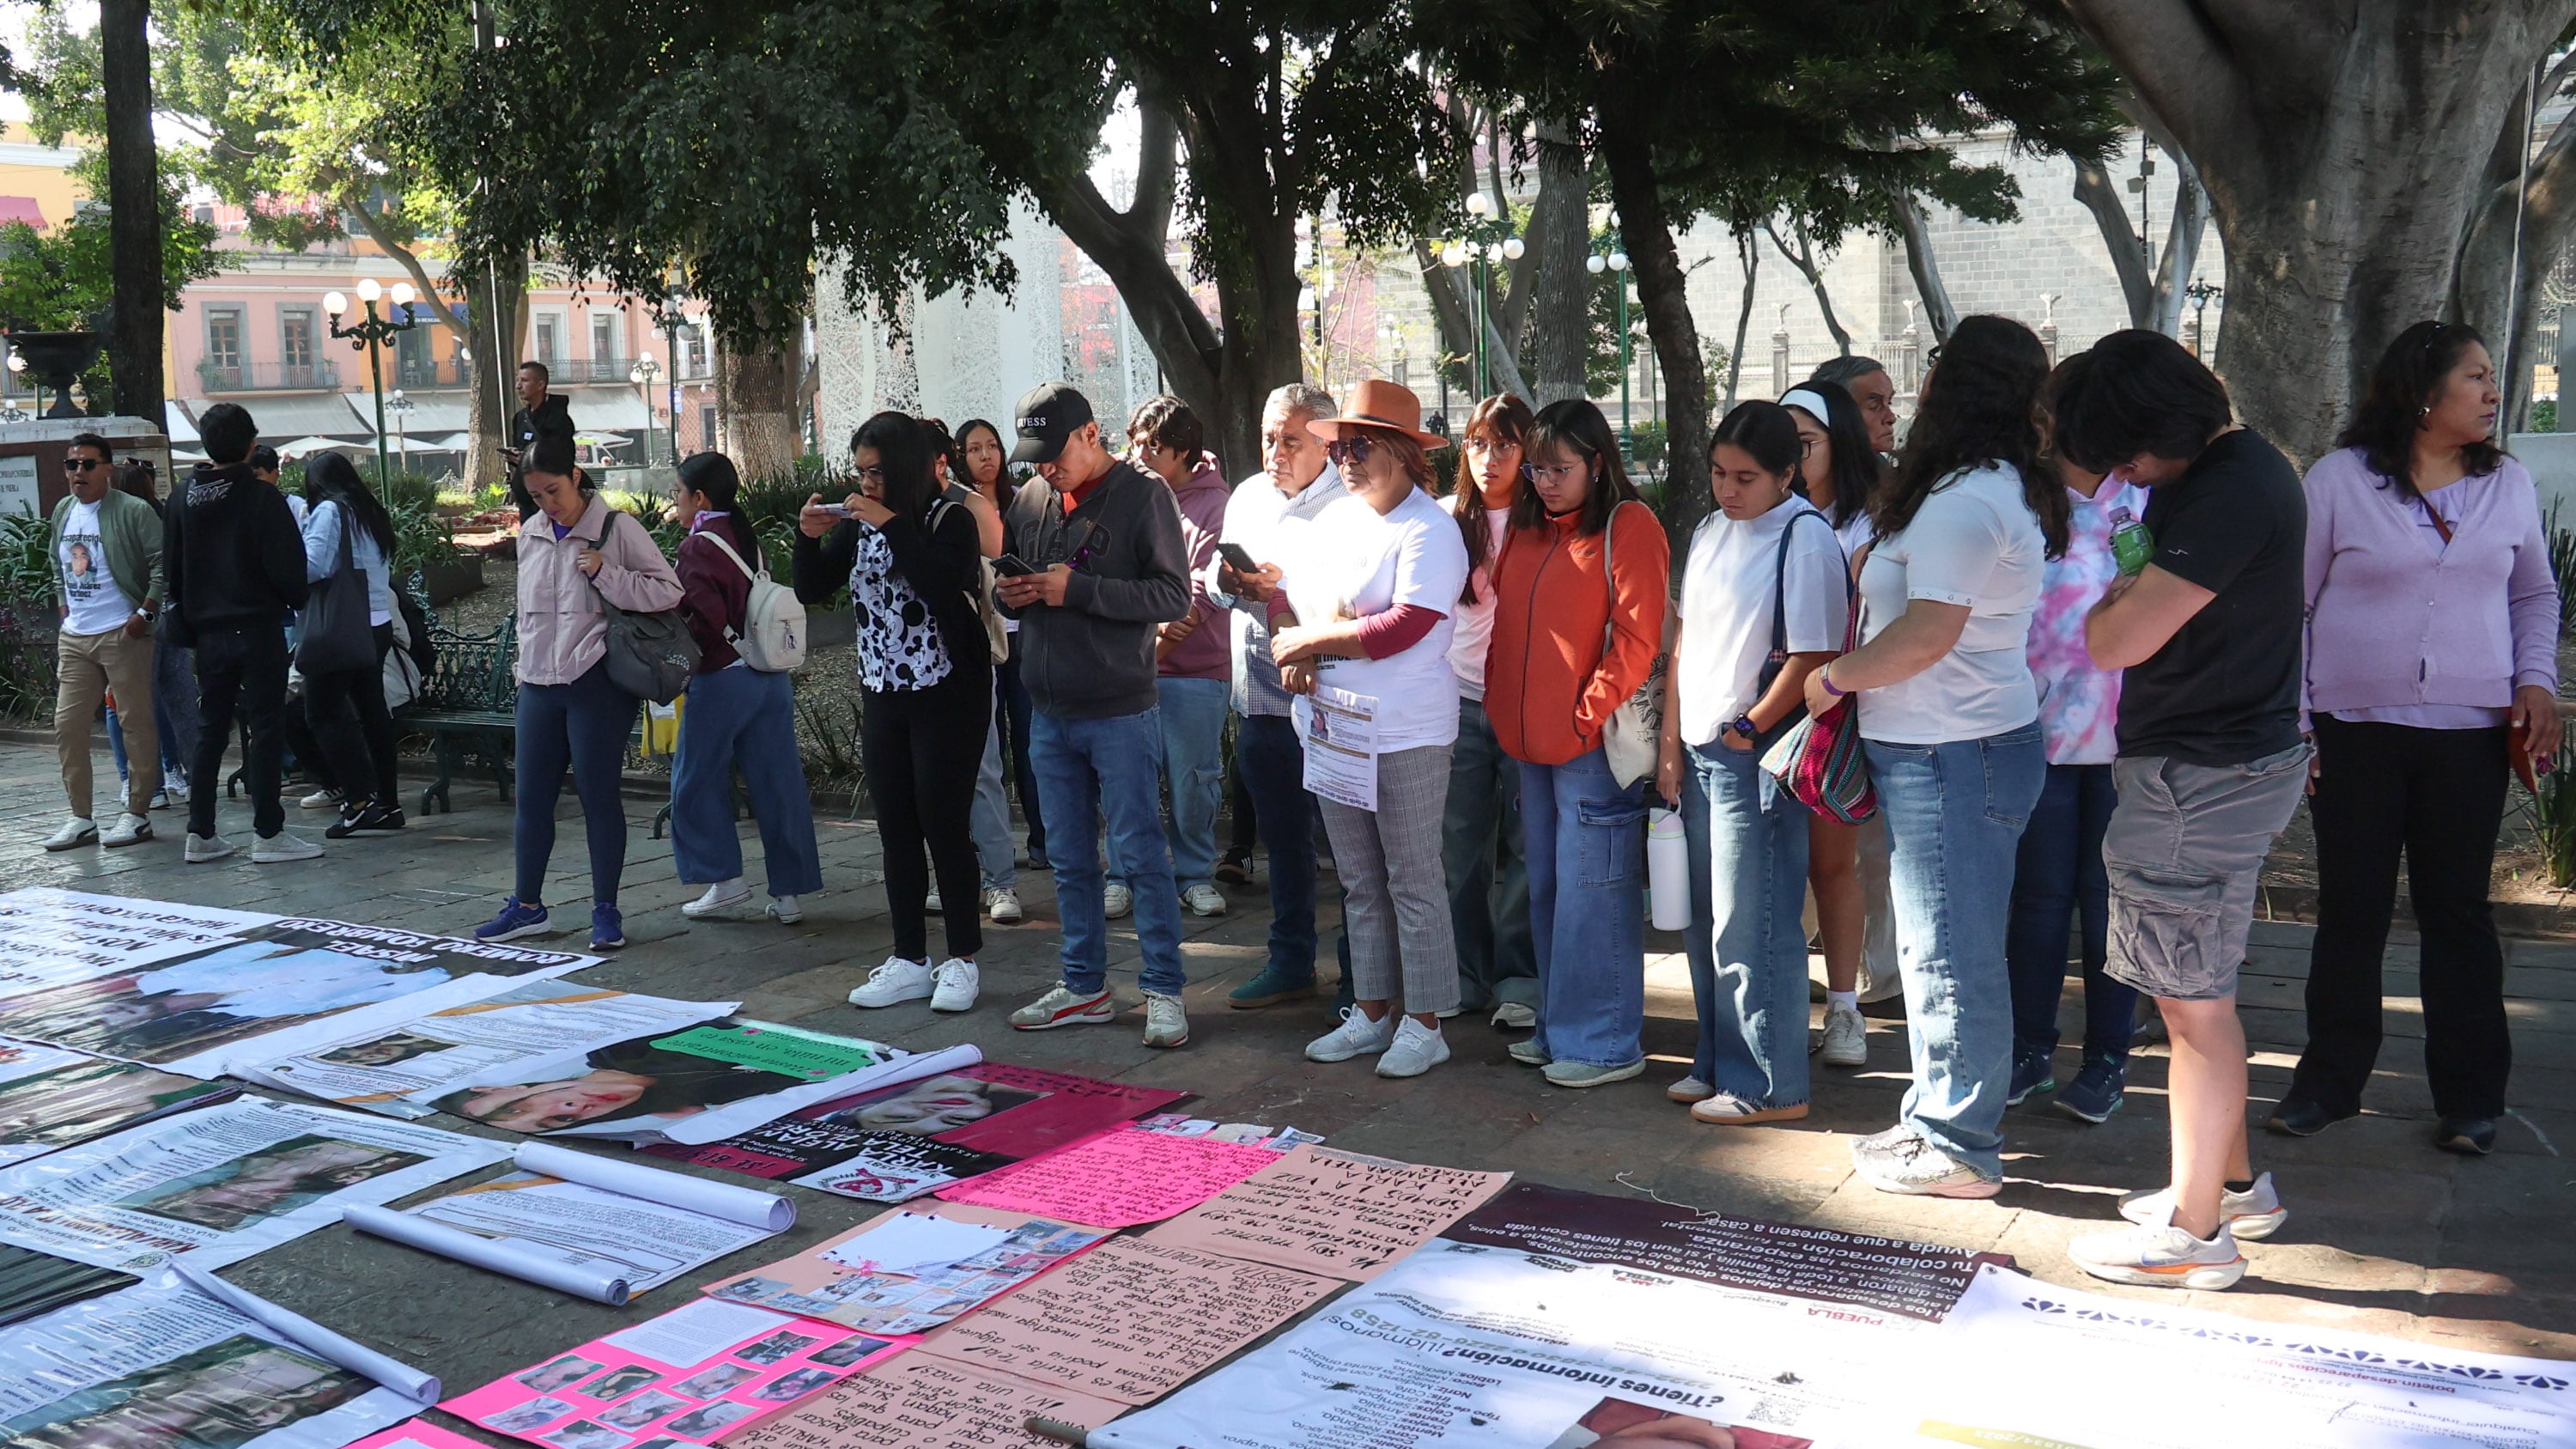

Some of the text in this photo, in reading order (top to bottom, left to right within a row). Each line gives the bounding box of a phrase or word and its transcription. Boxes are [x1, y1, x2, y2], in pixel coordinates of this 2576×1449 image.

[1017, 417, 1047, 428] GUESS
[275, 919, 573, 965] ROMERO SOMBRERO
[322, 940, 438, 963] MISAEL
[753, 1130, 859, 1151] ALEJAN
[861, 1137, 929, 1159] TELA
[857, 1147, 954, 1174] KARLA
[1309, 1154, 1486, 1188] ALEJANDRA TELA
[1272, 1173, 1466, 1211] SOMOS LA VOZ
[1346, 1172, 1473, 1197] DE KARLA
[1254, 1190, 1316, 1202] somos
[1315, 1190, 1453, 1219] una familia
[1199, 1209, 1235, 1222] soy
[1218, 1194, 1428, 1236] Somos una familia
[1240, 1219, 1268, 1227] no
[1504, 1222, 1536, 1233] vida
[1540, 1226, 1570, 1236] con
[1572, 1233, 1621, 1245] tienes
[1624, 1239, 1649, 1250] los
[1768, 1226, 1978, 1259] Ayuda que regresen
[1776, 1240, 1797, 1249] es
[1304, 1242, 1344, 1257] soy
[1648, 1251, 1683, 1263] solo
[1801, 1244, 1947, 1269] colaboración
[1128, 1260, 1178, 1275] porque
[1637, 1257, 1661, 1269] los
[1686, 1259, 1710, 1269] No
[1689, 1233, 1966, 1288] No perdamos las esperanza.
[1716, 1255, 1772, 1274] familia
[1951, 1261, 1974, 1273] Tu
[1084, 1263, 1111, 1275] con
[1663, 1263, 1716, 1278] donde
[1776, 1267, 1791, 1277] la
[1795, 1271, 1833, 1282] toda
[1792, 1277, 1815, 1287] ya
[1856, 1279, 1930, 1298] dañaron
[1106, 1279, 1226, 1312] sigo porque
[1902, 1296, 1941, 1308] algo
[1066, 1278, 1262, 1333] Sigo porque no me
[1087, 1301, 1117, 1315] hay
[1260, 1308, 1285, 1318] nos
[1905, 1305, 1932, 1318] los
[1041, 1311, 1121, 1335] diferentes
[1091, 1313, 1121, 1324] ven
[1146, 1310, 1207, 1328] archivar
[1807, 1307, 1884, 1326] PUEBLA
[1193, 1329, 1238, 1344] donde
[1214, 1326, 1250, 1338] para
[1319, 1314, 1445, 1354] ¡Llámanos!
[1091, 1338, 1133, 1353] nadie
[1127, 1333, 1155, 1347] las
[951, 1326, 1176, 1388] Mañana ser alguien
[1143, 1350, 1170, 1360] ya
[1174, 1355, 1203, 1370] Hoy
[1288, 1349, 1334, 1371] tabique
[1027, 1359, 1113, 1387] es Karla
[1442, 1347, 1618, 1388] información?
[907, 1390, 939, 1402] que
[974, 1382, 1014, 1397] una
[1618, 1379, 1724, 1409] ¿Tienes
[967, 1395, 987, 1404] se
[825, 1391, 943, 1429] para las
[1473, 1410, 1502, 1422] Tipo
[872, 1390, 1064, 1448] autoridades hagan su
[1405, 1411, 1452, 1425] Frente:
[793, 1413, 900, 1446] para buscar
[1392, 1422, 1445, 1439] Mentón:
